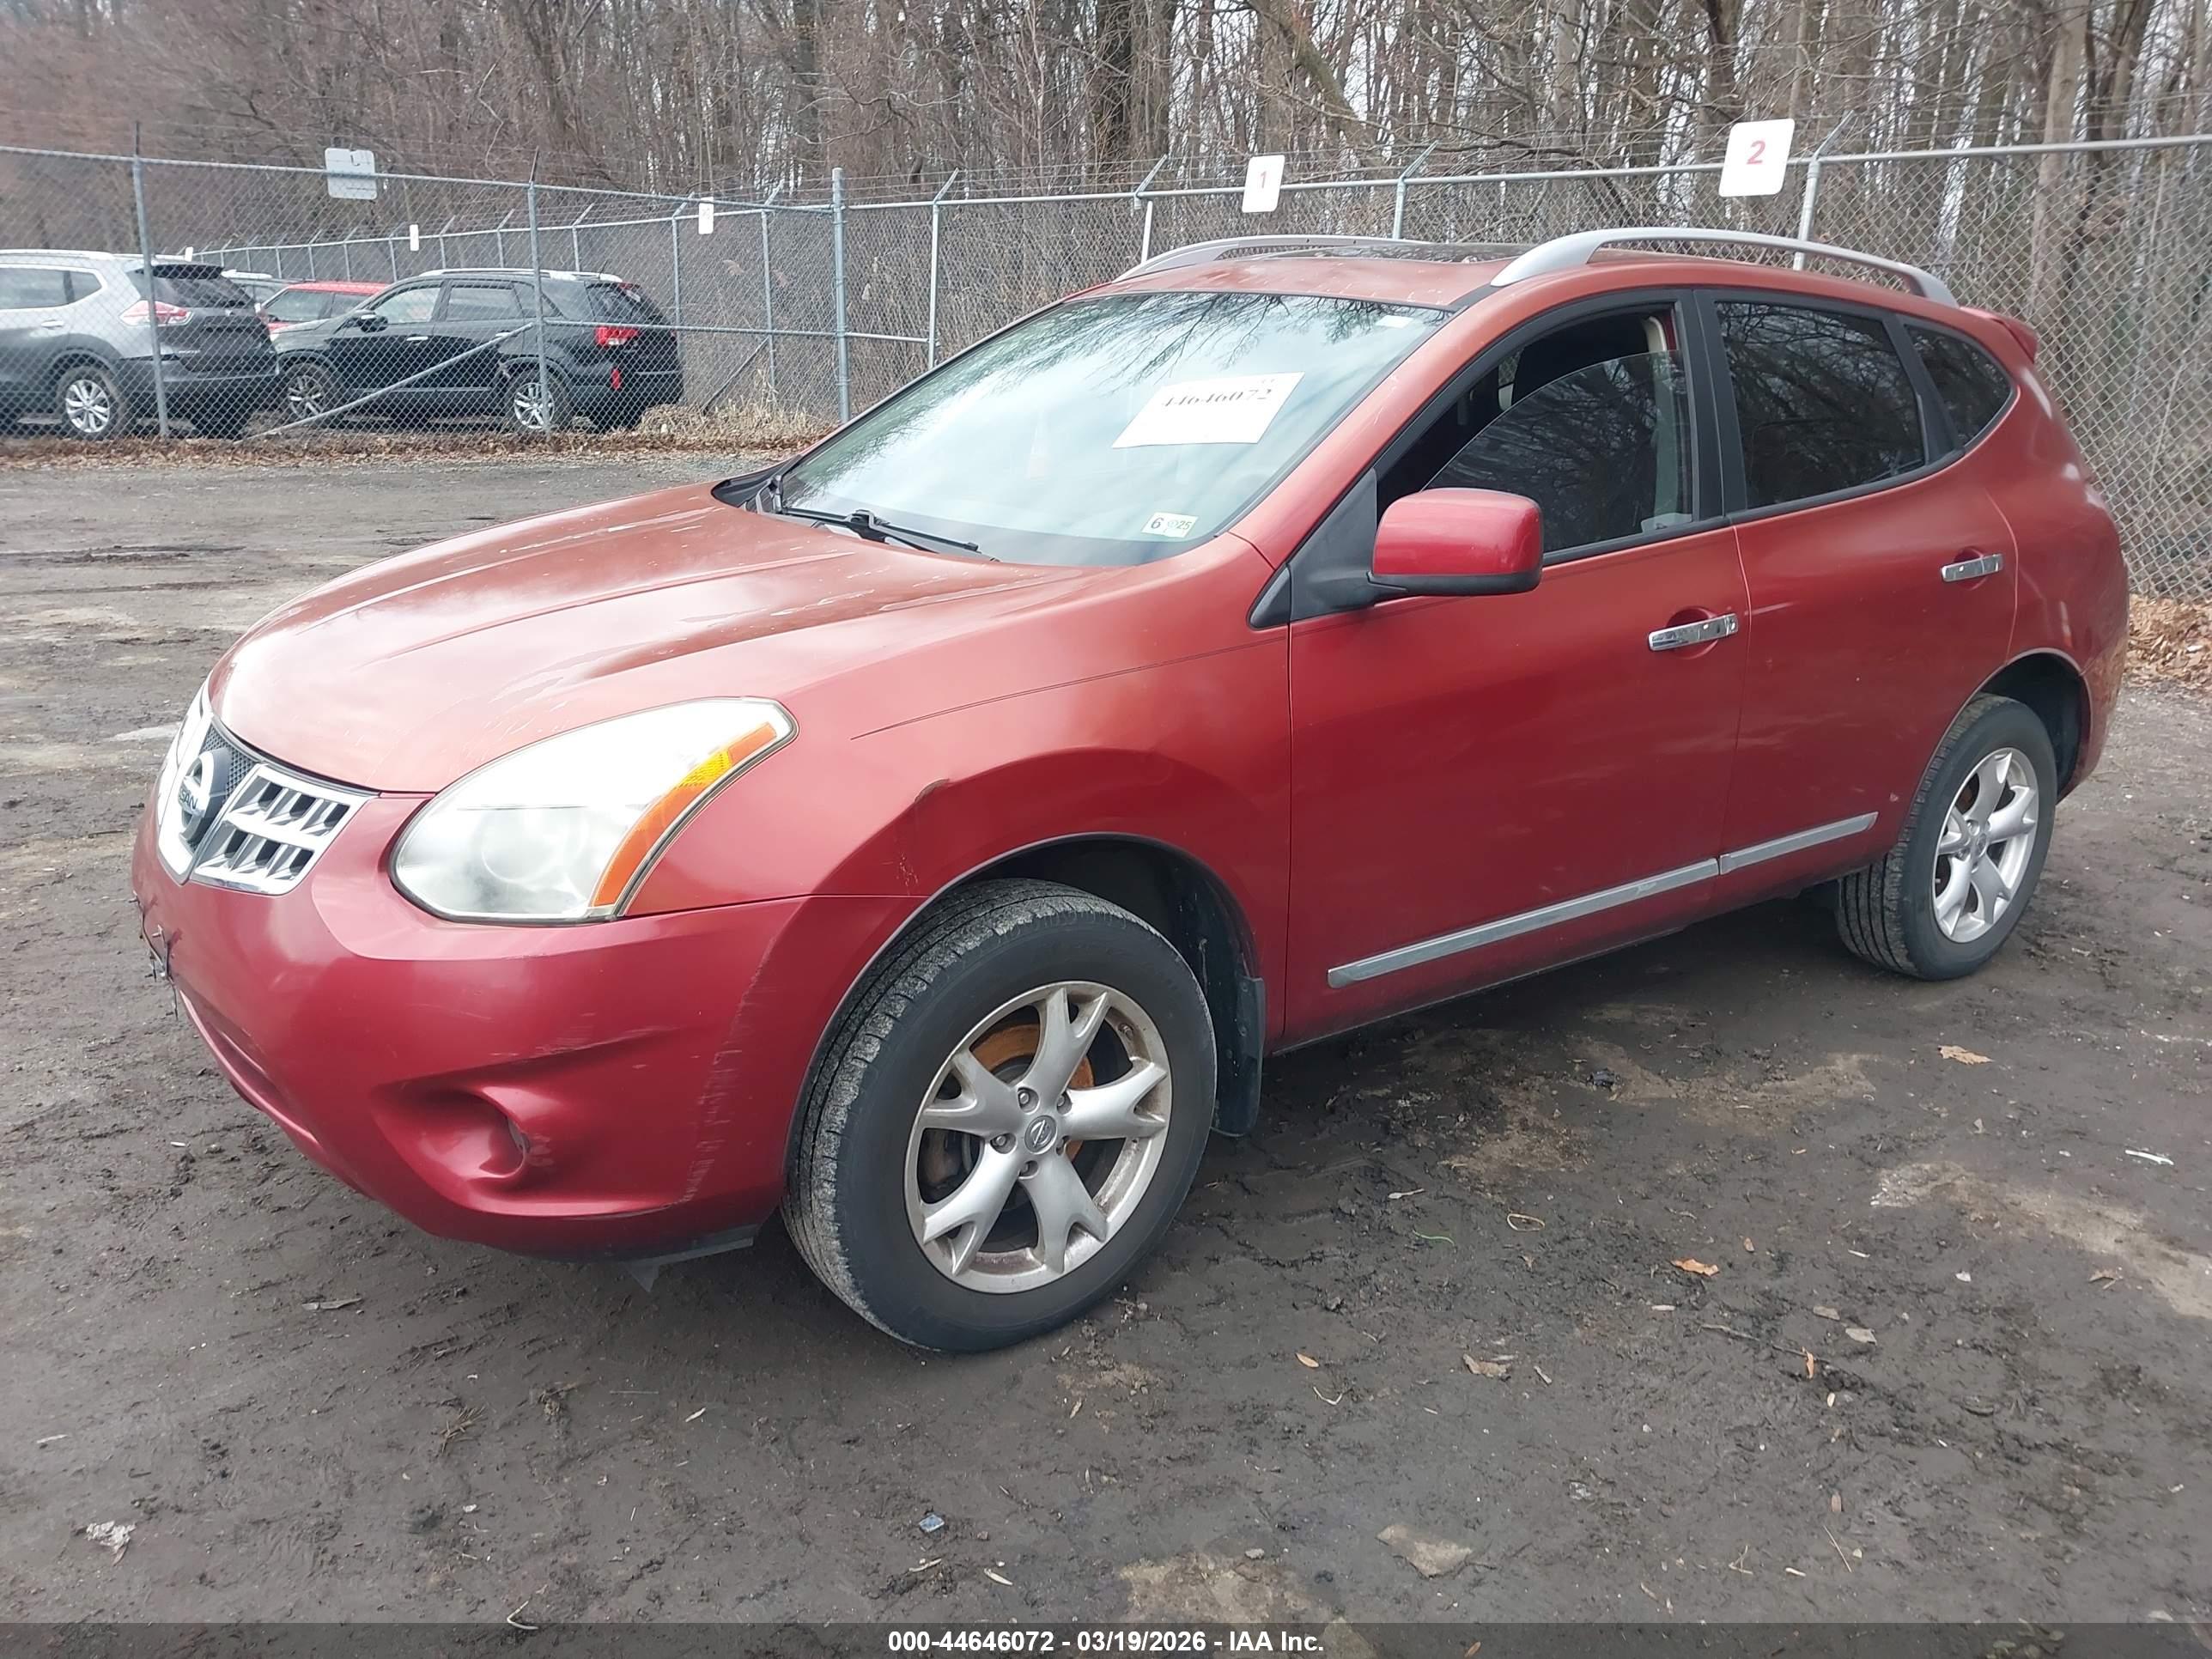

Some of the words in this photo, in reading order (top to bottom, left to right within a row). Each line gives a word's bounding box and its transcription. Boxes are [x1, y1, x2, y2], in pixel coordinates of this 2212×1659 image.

[1747, 140, 1766, 165] 2
[1260, 170, 1267, 189] 1
[1151, 517, 1164, 529] 6
[1176, 520, 1193, 530] 25
